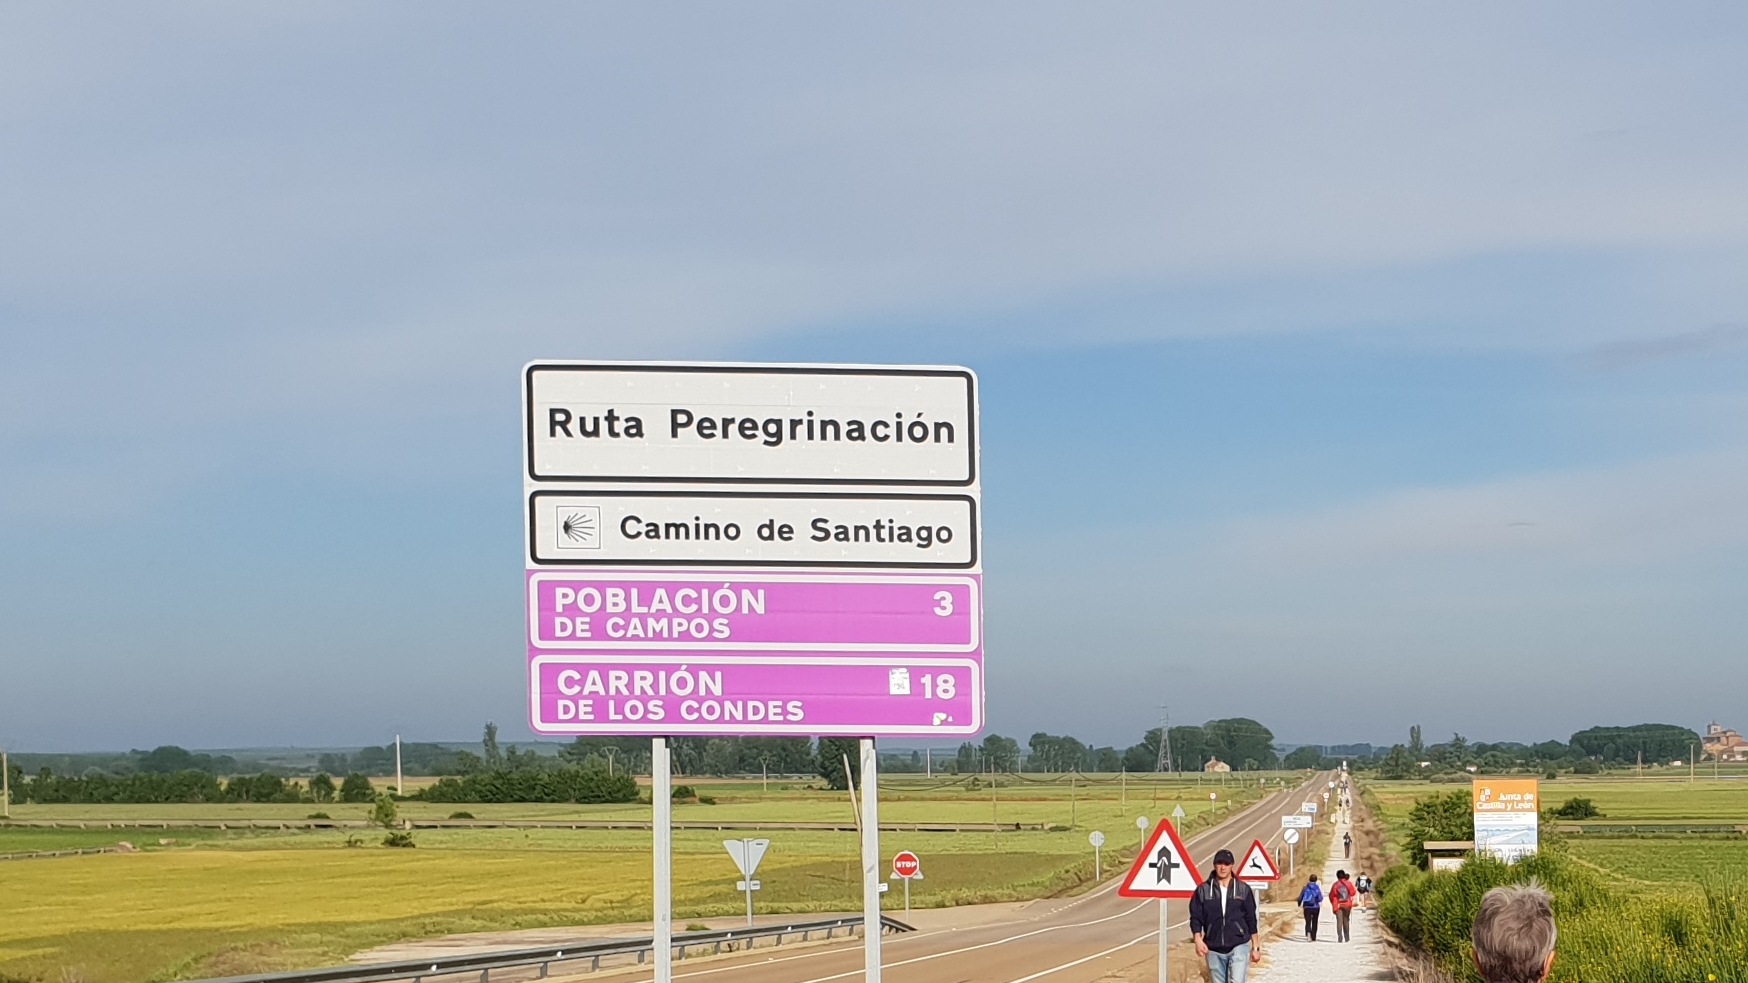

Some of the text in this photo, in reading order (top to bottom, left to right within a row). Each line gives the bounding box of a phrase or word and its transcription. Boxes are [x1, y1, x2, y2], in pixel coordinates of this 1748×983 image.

[548, 408, 956, 447] Ruta Peregrinación
[620, 515, 954, 549] Camino de Santiago
[555, 583, 954, 617] POBLACIÓN 3
[554, 617, 731, 639] DE CAMPOS
[556, 665, 723, 696] CARRIÓN
[920, 673, 956, 700] 18
[557, 699, 805, 722] DE LOS CONDES
[1476, 801, 1535, 811] Castilla y León
[1498, 793, 1534, 801] Junta de
